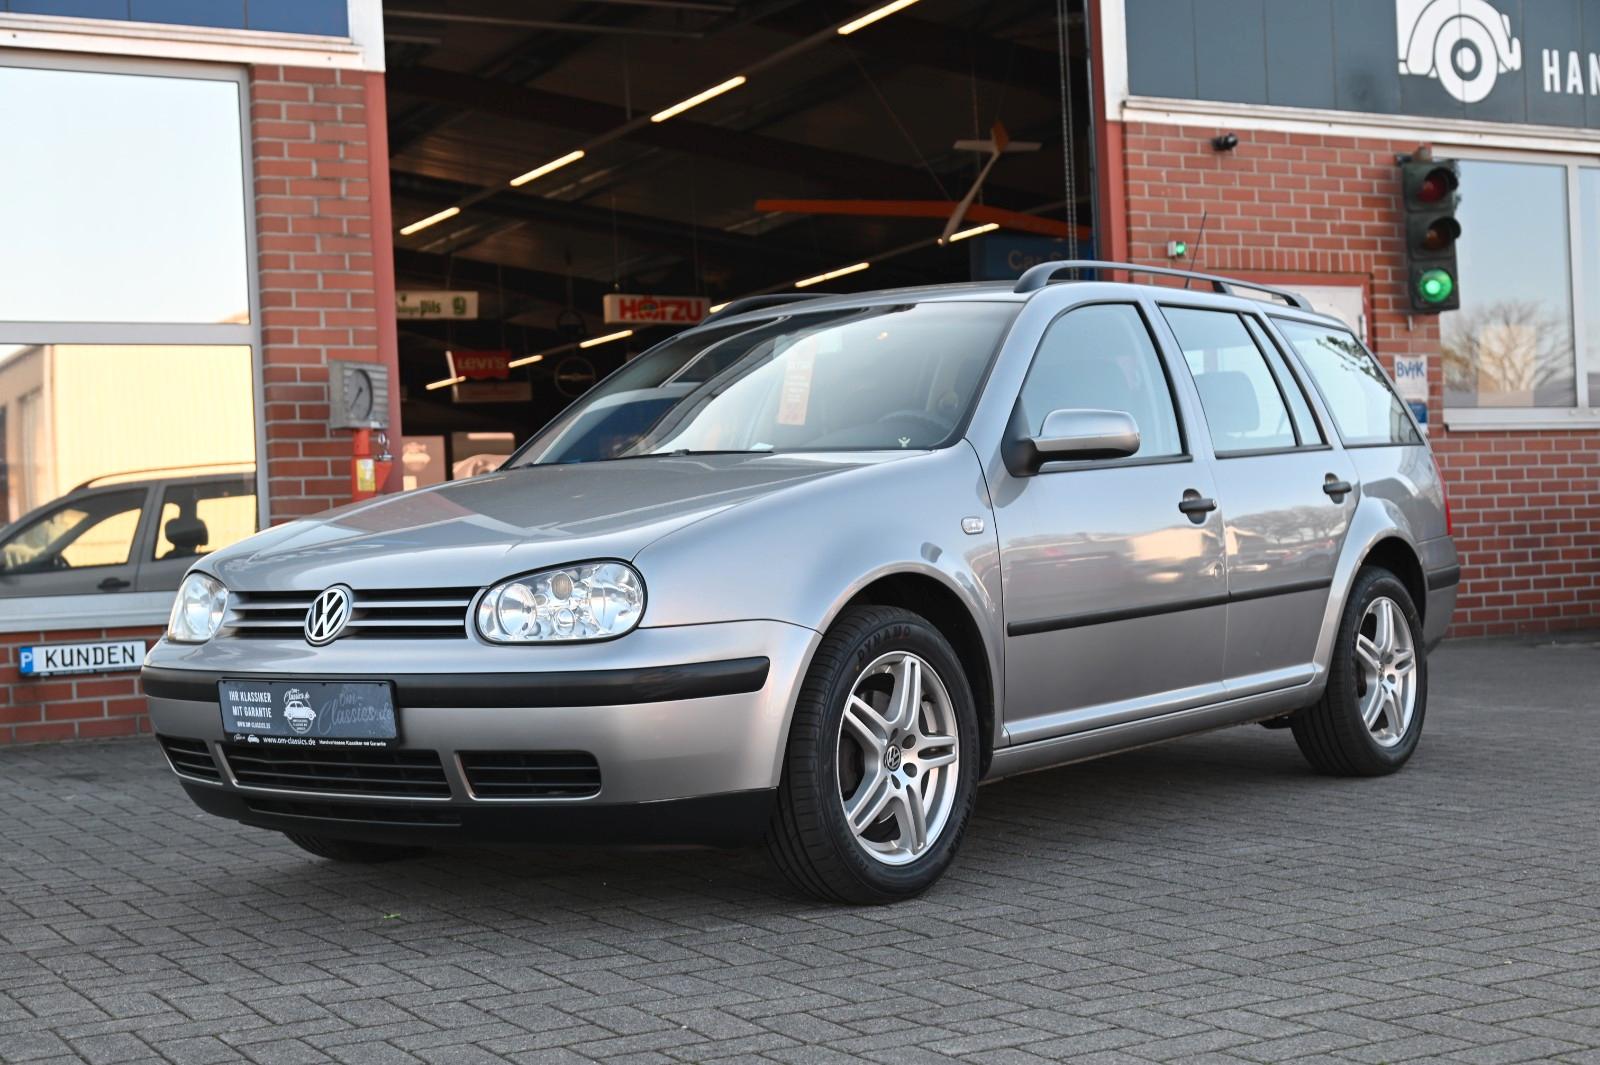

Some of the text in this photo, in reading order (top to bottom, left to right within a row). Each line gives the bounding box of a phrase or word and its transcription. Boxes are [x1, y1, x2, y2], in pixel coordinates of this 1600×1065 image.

[21, 645, 136, 668] P KUNDEN
[228, 690, 272, 703] IHR KLASSIKER
[232, 705, 272, 718] MIT GARANTIE
[263, 736, 316, 746] www.om-classics.de
